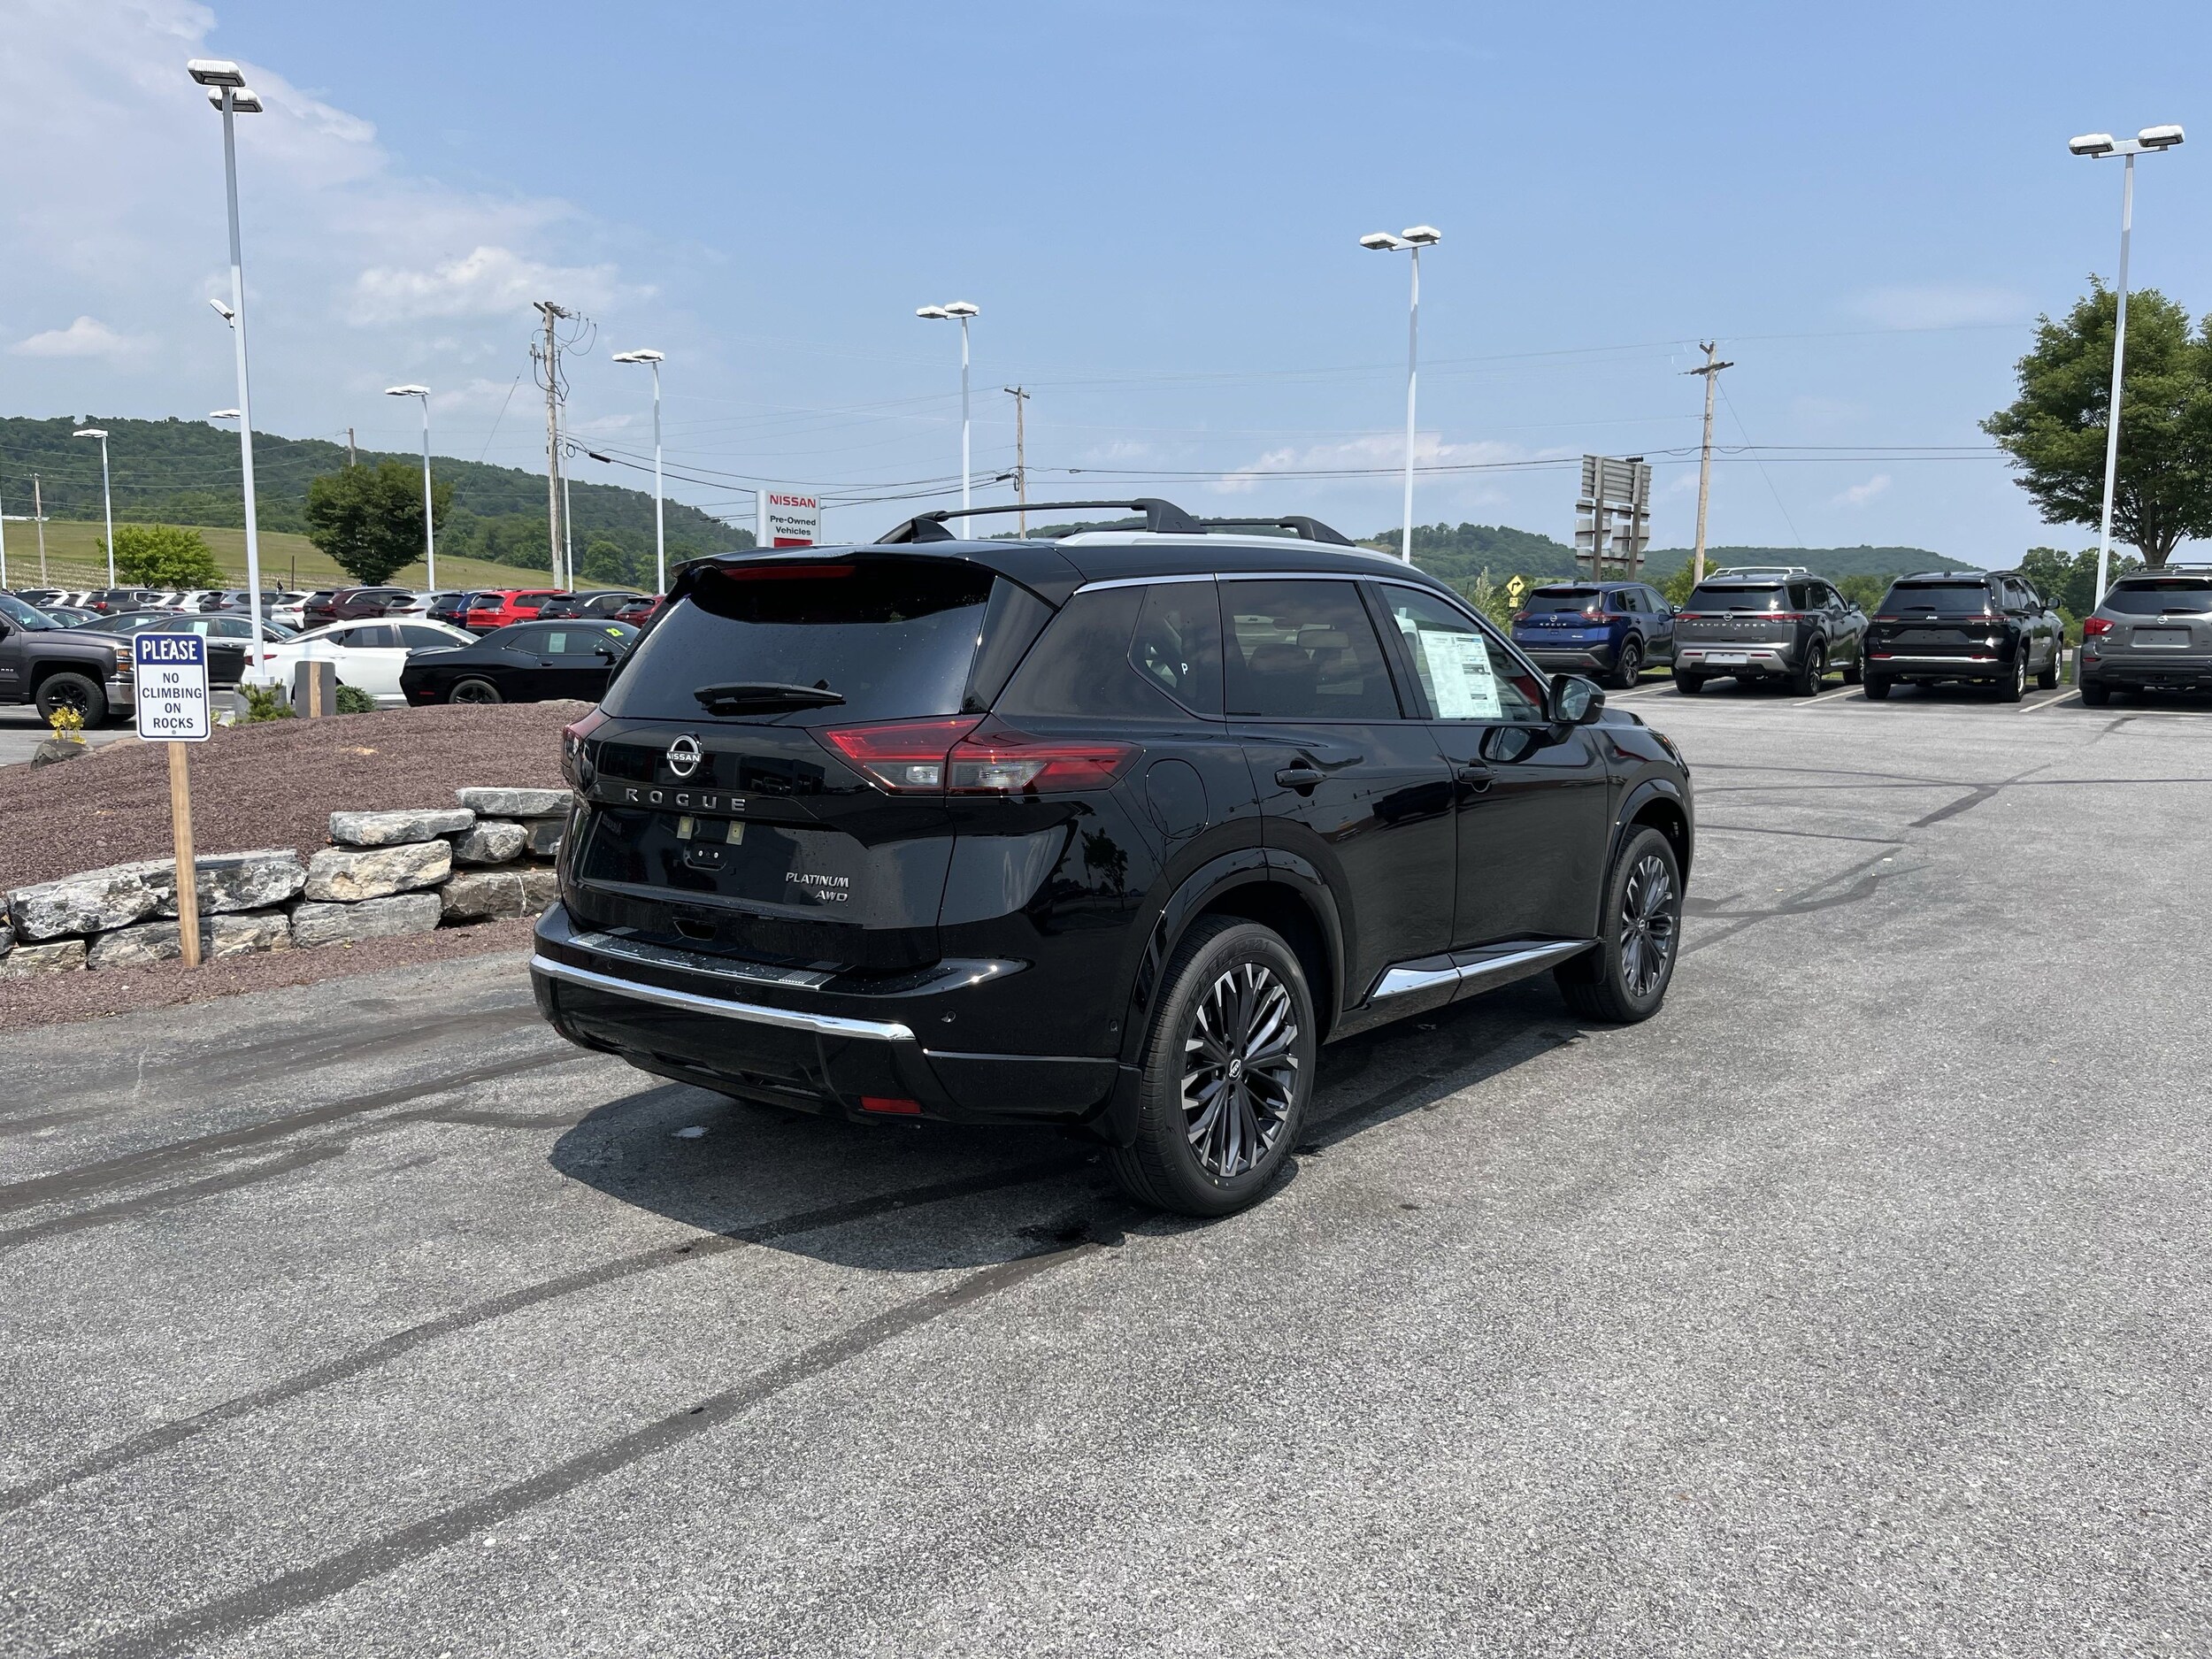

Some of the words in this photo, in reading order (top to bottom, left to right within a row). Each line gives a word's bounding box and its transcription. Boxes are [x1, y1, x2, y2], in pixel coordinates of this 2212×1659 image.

[770, 495, 816, 508] NISSAN
[770, 515, 816, 526] Pre-Owned
[776, 526, 811, 535] Vehicles
[142, 640, 198, 660] PLEASE
[163, 672, 180, 683] NO
[142, 687, 203, 698] CLIMBING
[165, 703, 181, 713] ON
[153, 718, 194, 728] ROCKS
[666, 752, 700, 762] NISSAN
[625, 787, 746, 811] ROGUE
[785, 872, 849, 888] PLATINUM
[815, 889, 849, 902] AWD
